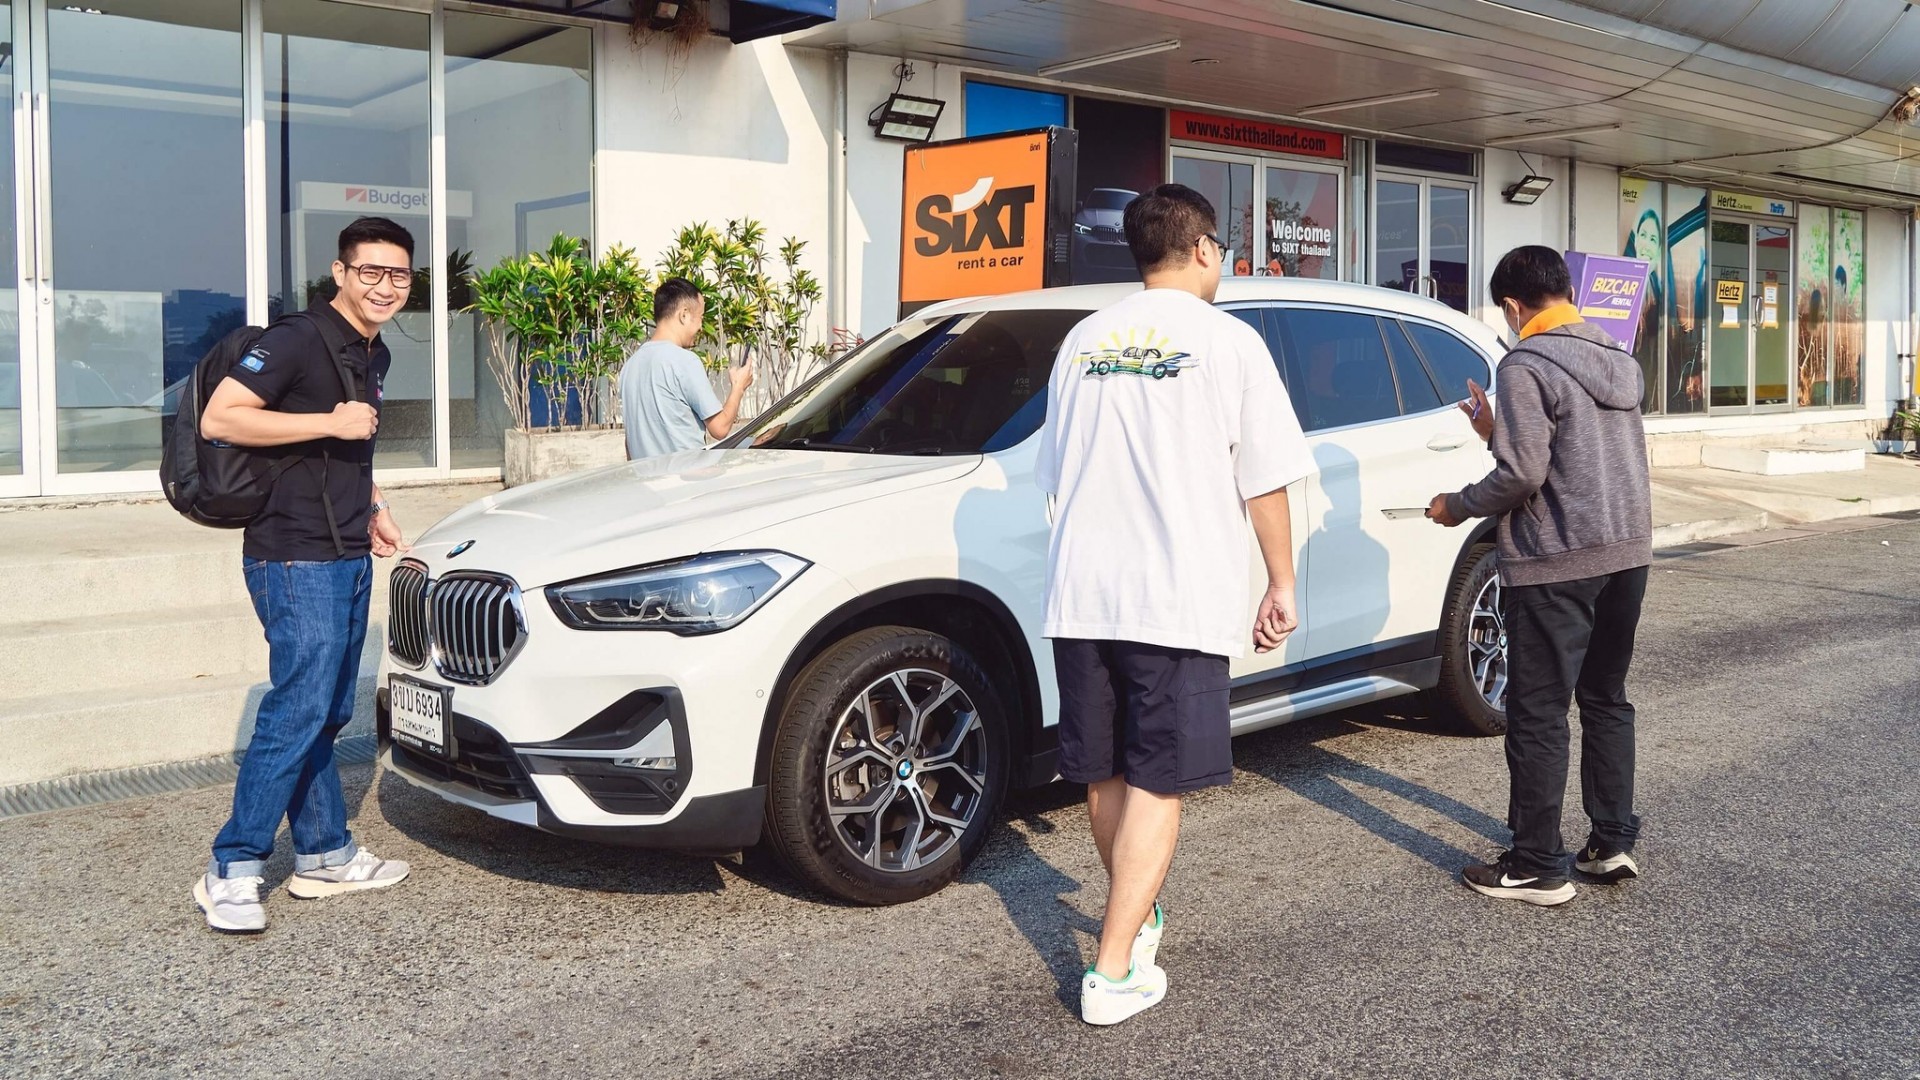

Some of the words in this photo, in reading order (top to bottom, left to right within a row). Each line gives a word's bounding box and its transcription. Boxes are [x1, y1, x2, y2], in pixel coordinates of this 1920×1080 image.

[1186, 120, 1326, 151] www.sixtthailand.com
[369, 189, 428, 210] Budget
[1622, 188, 1638, 199] Hertz
[1717, 194, 1737, 208] Hertz
[1271, 219, 1332, 243] Welcome
[1272, 241, 1281, 253] to
[1282, 242, 1300, 254] SIXT
[1301, 244, 1331, 257] thailand
[957, 255, 985, 270] rent
[989, 257, 997, 268] a
[1001, 255, 1024, 267] car
[1720, 267, 1740, 280] Hertz
[1591, 277, 1640, 296] BIZCAR
[1719, 283, 1740, 297] Hertz
[1611, 297, 1633, 307] RENTAL
[416, 691, 441, 721] 6934
